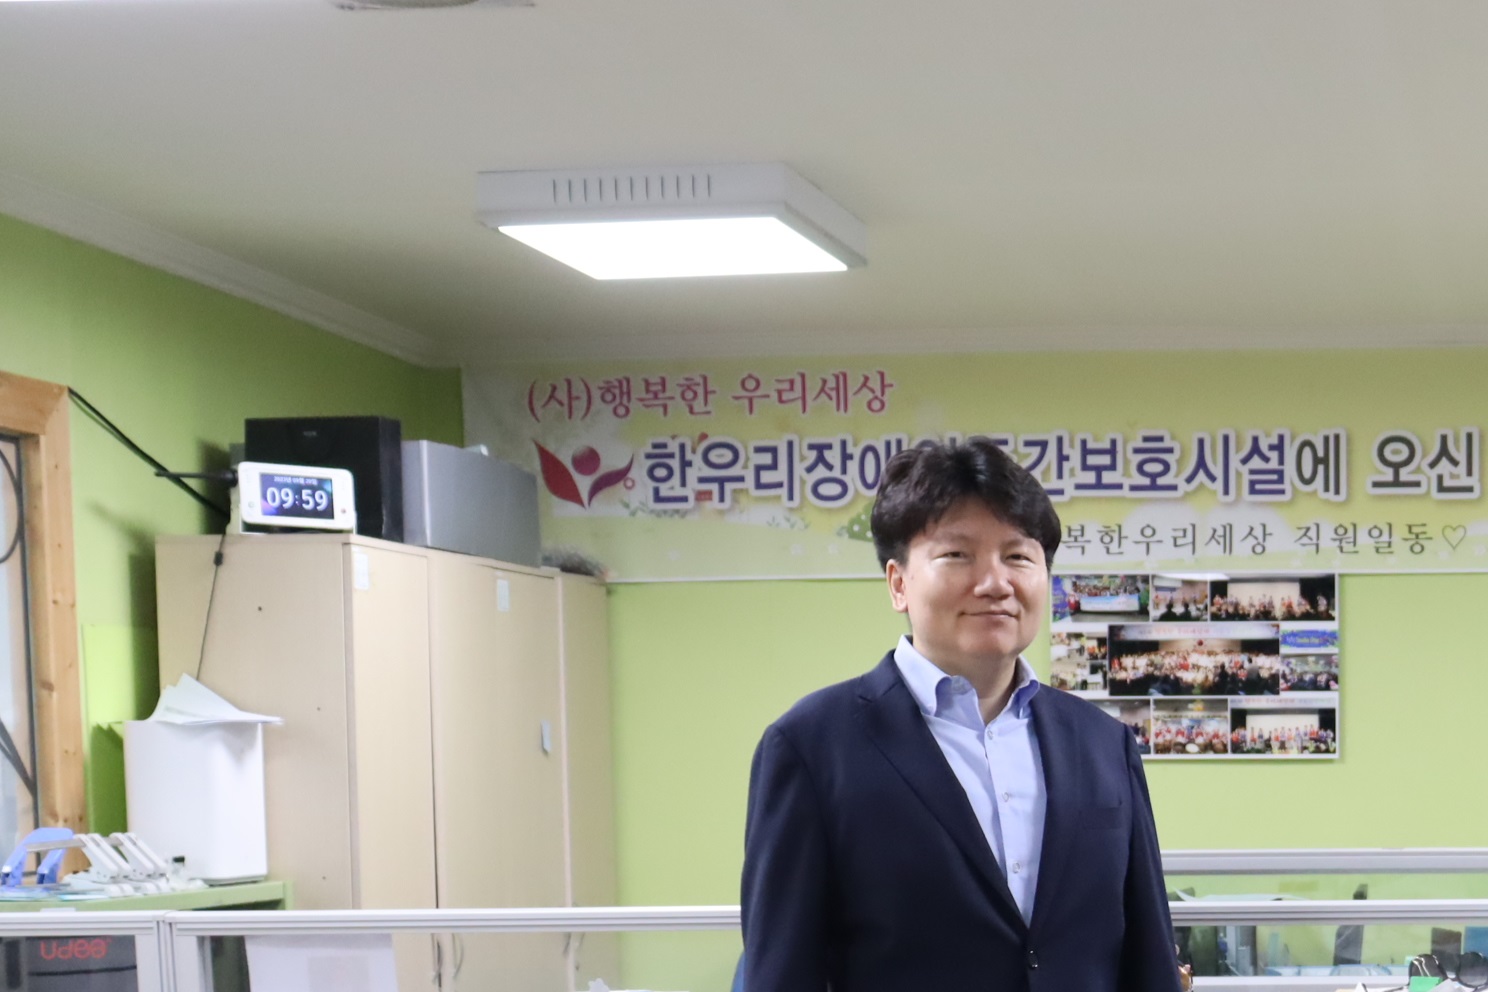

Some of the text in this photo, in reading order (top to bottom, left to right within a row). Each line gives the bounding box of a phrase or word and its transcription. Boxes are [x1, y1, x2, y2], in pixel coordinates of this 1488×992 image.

[526, 370, 894, 421] (사)행복한 우리세상
[643, 431, 1344, 501] 한우리장애간보호시설에
[1371, 431, 1478, 494] 오신
[266, 486, 328, 511] 09:59
[1061, 522, 1273, 556] 복한우리세상
